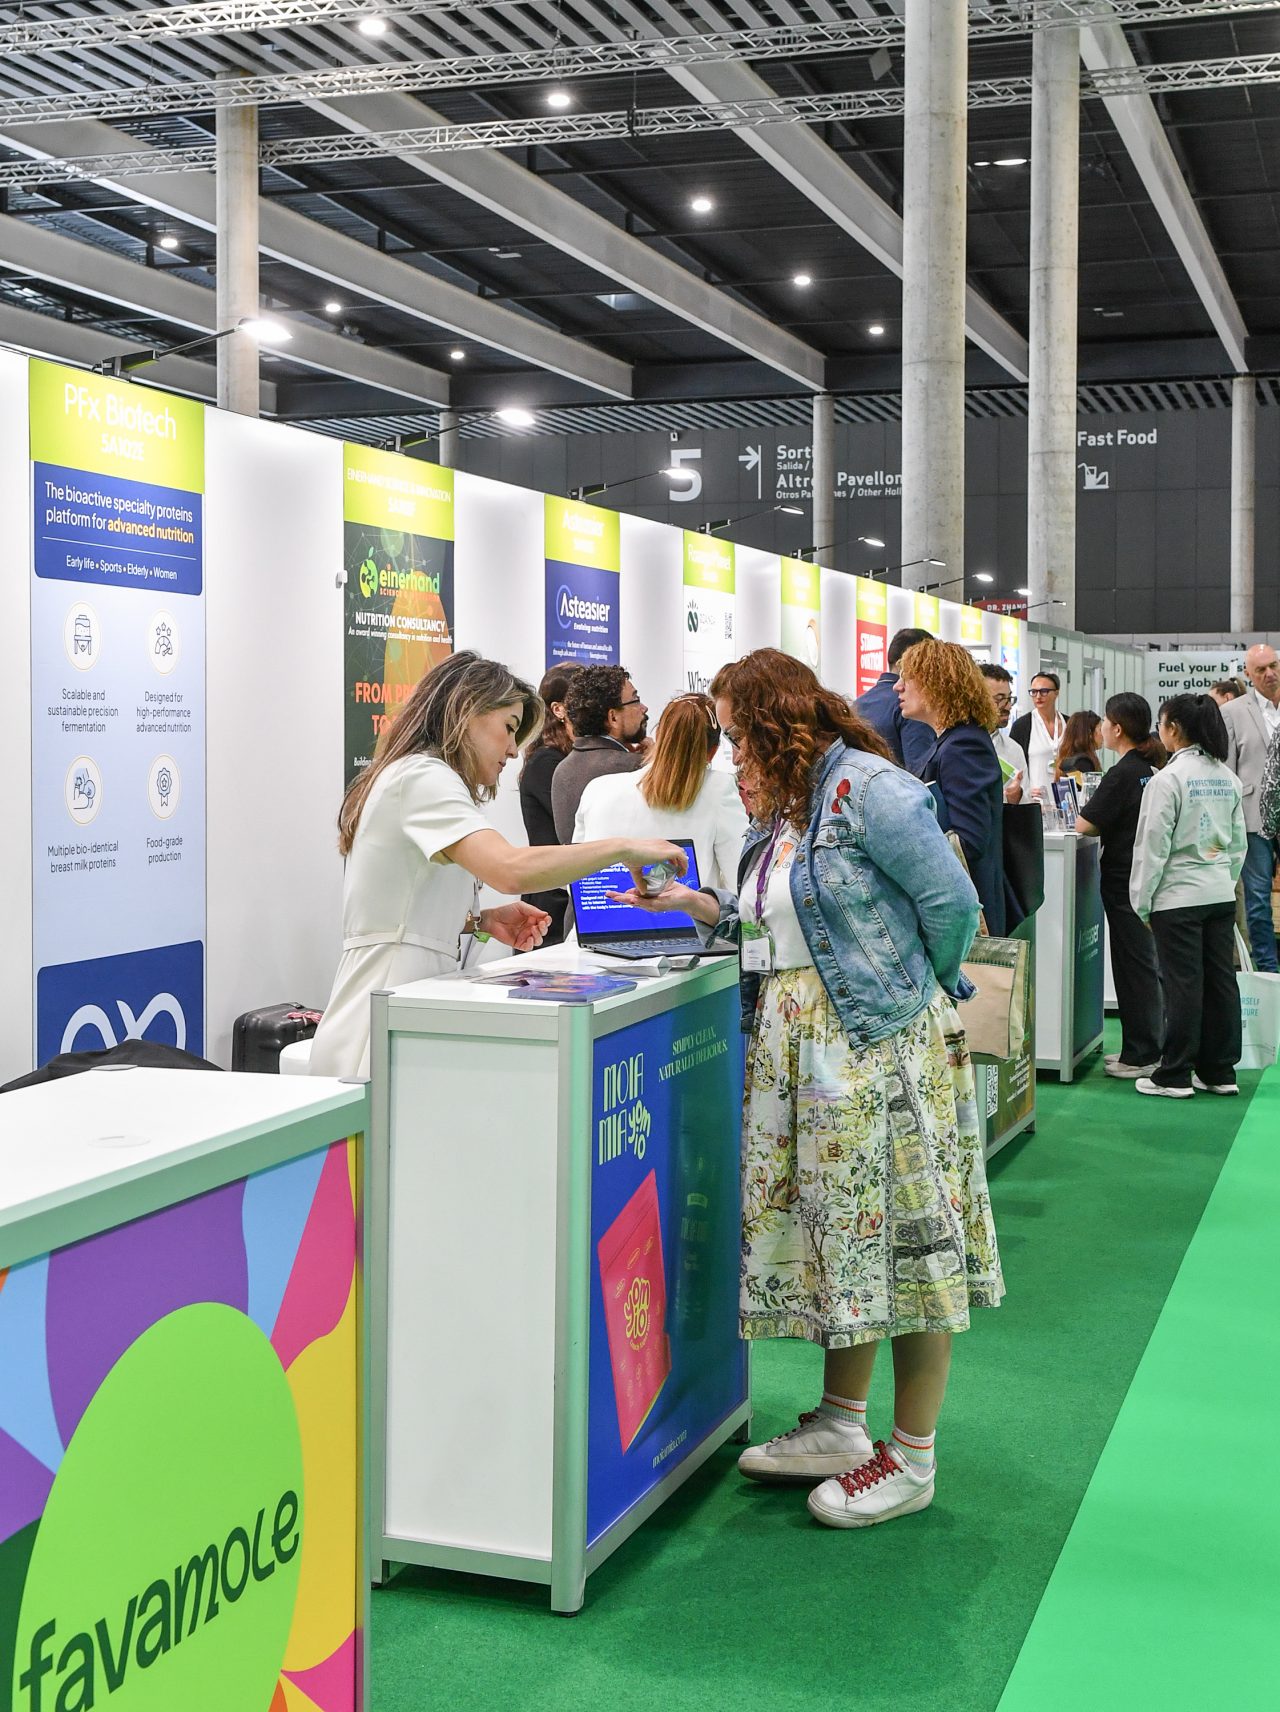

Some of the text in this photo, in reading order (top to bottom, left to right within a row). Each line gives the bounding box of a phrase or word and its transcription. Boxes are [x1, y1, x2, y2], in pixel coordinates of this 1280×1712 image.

[64, 382, 177, 441] PFx Biotech
[1077, 428, 1157, 447] Fast Food
[776, 461, 803, 471] Salida
[669, 448, 702, 502] 5
[837, 471, 902, 487] Pavellon
[776, 490, 799, 499] Otros
[857, 487, 882, 497] Other
[45, 481, 193, 523] The bioactive specialty proteins
[46, 506, 194, 544] platform for advanced nutrition
[66, 555, 178, 580] Early life Sports Elderly Women
[379, 564, 440, 594] einerhand
[560, 592, 610, 622] Asteasier
[355, 612, 446, 633] NUTRITION CONSULTANCY
[1158, 662, 1185, 673] Fuel
[1188, 664, 1217, 674] your
[1158, 680, 1180, 688] our
[62, 688, 106, 701] Scalable and
[144, 691, 184, 706] Designed for
[355, 682, 392, 704] FROM
[47, 705, 119, 718] sustainable precision
[136, 706, 191, 721] high-performance
[61, 721, 106, 733] fermentation
[136, 722, 192, 733] advanced nutrition
[47, 841, 119, 858] Multiple bio-identical
[146, 835, 183, 849] Food-grade
[50, 857, 116, 873] breast milk proteins
[148, 851, 182, 865] production
[1241, 997, 1260, 1006] RSELF
[19, 1489, 300, 1712] favamole
